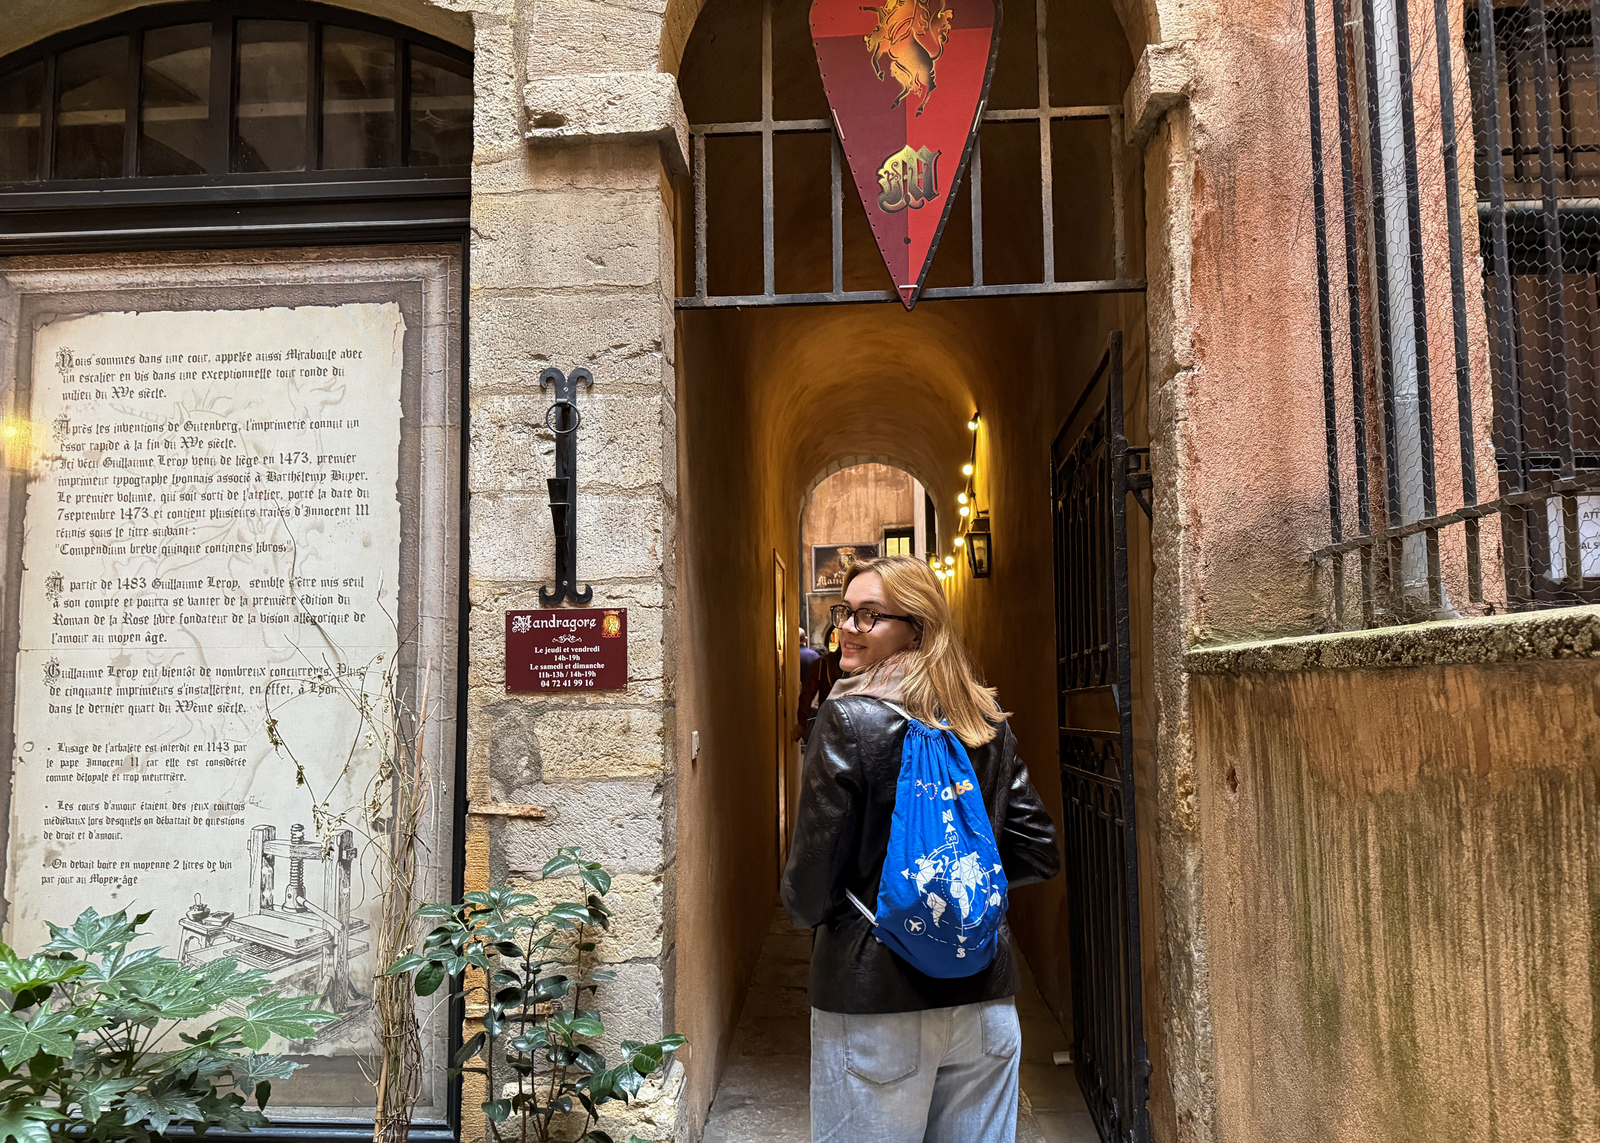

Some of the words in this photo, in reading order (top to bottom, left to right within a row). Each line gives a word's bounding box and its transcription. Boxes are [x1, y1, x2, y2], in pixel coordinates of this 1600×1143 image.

[95, 356, 136, 365] sommes
[139, 354, 163, 364] dans
[166, 354, 184, 364] une
[255, 351, 282, 361] aussi
[340, 349, 362, 359] avec
[61, 374, 75, 383] un
[79, 372, 116, 383] escalier
[119, 373, 131, 382] en
[134, 371, 150, 381] vis
[152, 370, 176, 380] dans
[179, 371, 198, 380] une
[201, 368, 272, 381] exceptionnelle
[276, 369, 296, 378] tour
[300, 366, 328, 377] ronde
[332, 366, 345, 376] du
[62, 390, 92, 401] milieu
[95, 389, 108, 401] du
[111, 388, 135, 398] XVe
[96, 424, 111, 434] les
[113, 422, 165, 434] inventions
[168, 422, 179, 432] de
[310, 420, 343, 429] connut
[346, 420, 359, 428] un
[60, 442, 86, 453] essor
[89, 440, 120, 454] rapide
[134, 440, 142, 451] la
[146, 439, 160, 450] fin
[164, 438, 176, 449] du
[180, 438, 204, 451] XVe
[102, 457, 156, 469] Guillaume
[157, 455, 188, 469] Leroy
[220, 455, 232, 466] de
[262, 456, 275, 466] en
[317, 453, 357, 466] premier
[58, 476, 110, 488] imprimeur
[113, 474, 168, 488] typographe
[170, 473, 215, 488] lyonnais
[75, 493, 114, 505] premier
[160, 492, 177, 504] qui
[179, 491, 199, 501] soit
[200, 491, 224, 501] sorti
[227, 490, 239, 500] de
[288, 489, 314, 503] porte
[318, 489, 327, 500] la
[331, 488, 353, 498] date
[356, 488, 369, 498] du
[120, 508, 150, 521] 1473
[153, 510, 163, 519] et
[167, 509, 206, 520] contient
[209, 506, 259, 522] plusieurs
[89, 528, 113, 538] sous
[128, 527, 150, 538] titre
[152, 524, 190, 537] suivant
[158, 544, 201, 557] quinque
[205, 543, 252, 554] continens
[69, 580, 97, 592] partir
[117, 578, 147, 590] 1483
[151, 578, 204, 590] Guillaume
[249, 576, 285, 588] semble
[320, 578, 339, 587] mis
[342, 576, 364, 588] seul
[63, 599, 81, 608] son
[84, 598, 120, 609] compte
[136, 598, 169, 610] pourra
[187, 595, 220, 606] vanter
[52, 614, 90, 626] Roman
[121, 613, 150, 625] Rose
[153, 613, 178, 626] livre
[179, 613, 228, 624] fondateur
[260, 612, 290, 624] vision
[512, 614, 597, 633] Mandragore
[108, 634, 141, 645] moyen
[534, 646, 544, 654] Le
[545, 646, 562, 655] jeudi
[571, 645, 600, 653] vendredi
[529, 663, 539, 671] Le
[540, 663, 564, 671] samedi
[572, 662, 605, 670] dimanche
[107, 666, 138, 681] Leroy
[142, 668, 158, 679] eut
[215, 666, 266, 677] nombreux
[538, 671, 565, 679] 11h-13h
[570, 670, 597, 678] 14h-19h
[540, 680, 550, 688] 04
[552, 680, 561, 688] 72
[573, 679, 583, 687] 99
[585, 679, 594, 687] 16
[65, 686, 113, 698] cinquante
[116, 686, 174, 698] imprimeurs
[48, 703, 73, 714] dans
[88, 703, 125, 714] dernier
[128, 704, 155, 716] quart
[145, 745, 159, 753] est
[160, 742, 190, 752] interdit
[206, 742, 230, 753] 1143
[234, 745, 247, 753] par
[60, 760, 80, 769] pape
[86, 757, 123, 768] Innocent
[165, 758, 180, 768] elle
[46, 774, 74, 782] comme
[123, 773, 139, 783] trop
[57, 801, 74, 811] Les
[78, 803, 100, 811] cours
[172, 801, 187, 810] des
[190, 802, 209, 812] jeux
[213, 802, 245, 811] courtois
[88, 816, 104, 826] lors
[105, 816, 142, 827] desquels
[205, 817, 246, 827] questions
[942, 809, 954, 823] N
[56, 831, 75, 841] droit
[70, 860, 95, 869] devait
[97, 860, 117, 869] boire
[133, 862, 171, 872] moyenne
[173, 860, 179, 869] 2
[182, 860, 204, 870] litres
[219, 860, 232, 870] vin
[41, 876, 55, 885] par
[57, 876, 74, 885] jour
[956, 947, 966, 958] S
